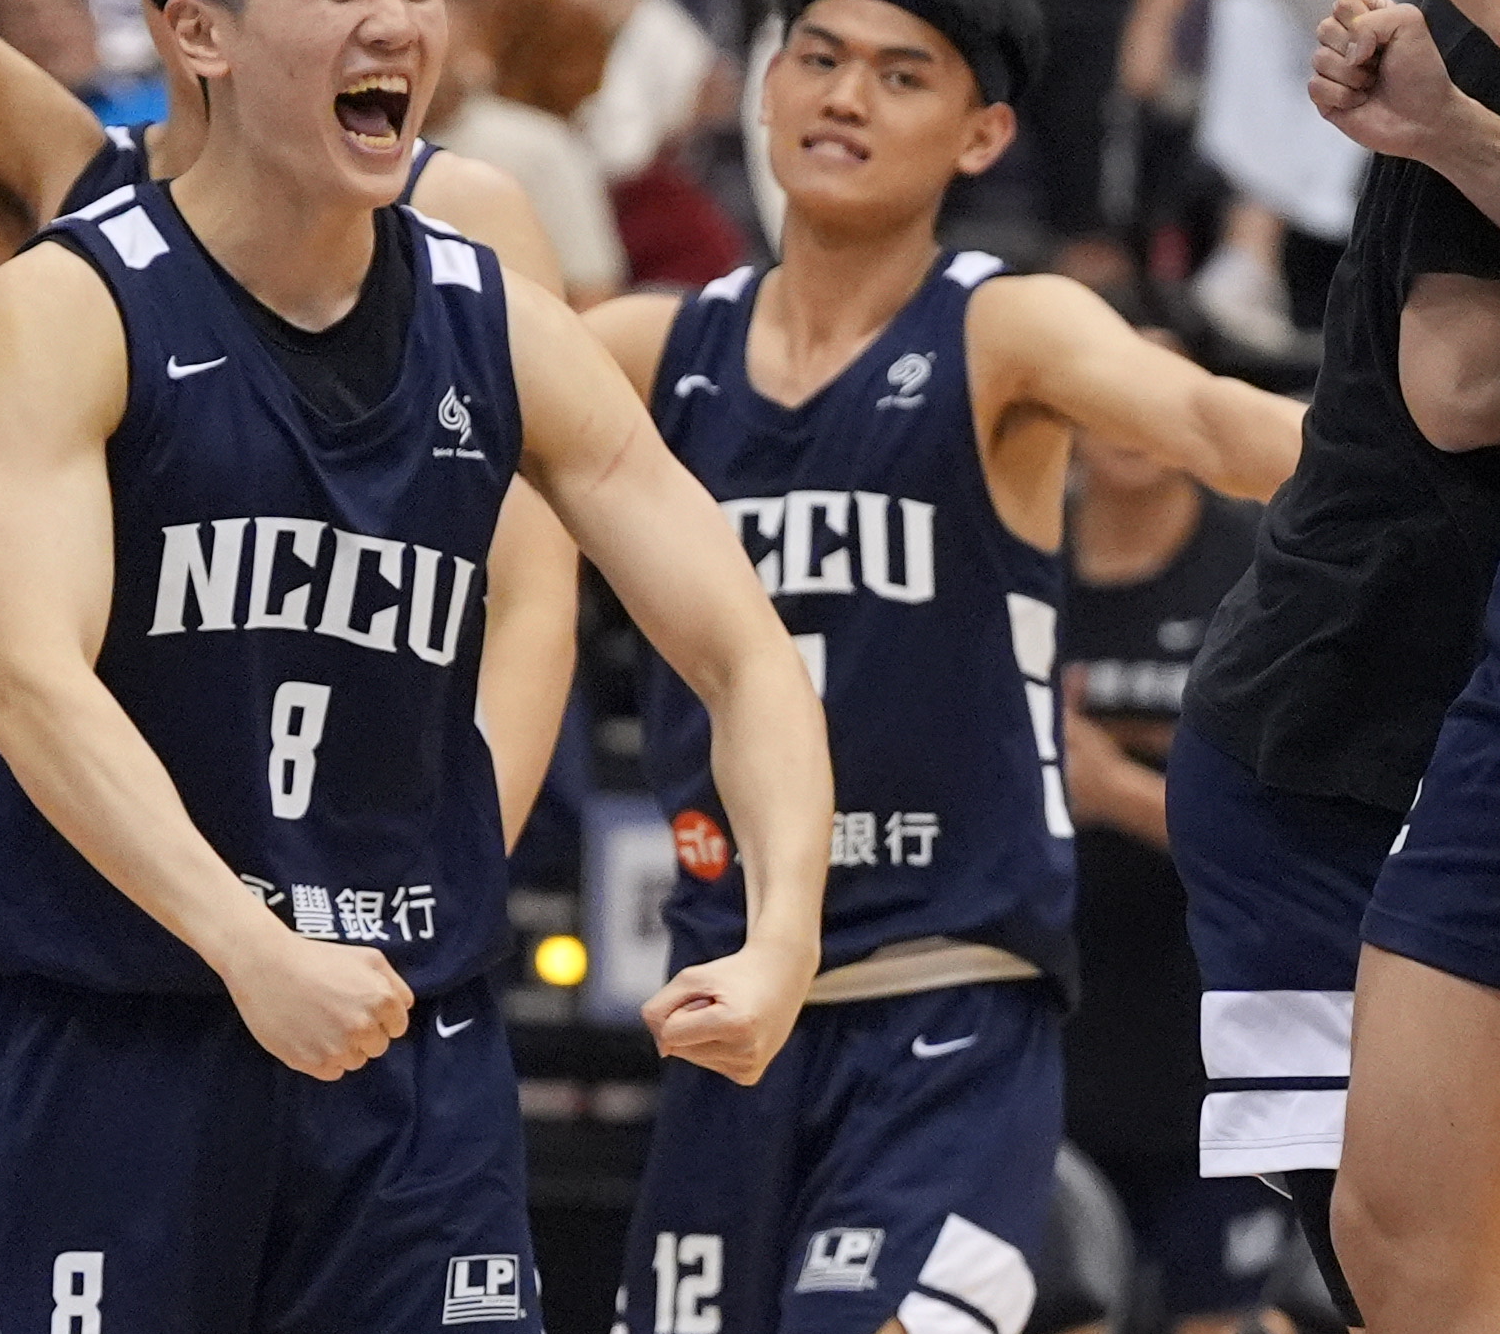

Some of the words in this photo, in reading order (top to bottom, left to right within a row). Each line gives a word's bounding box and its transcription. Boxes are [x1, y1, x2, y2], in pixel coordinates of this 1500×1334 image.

[147, 516, 476, 667] NCCU
[719, 489, 937, 605] CCU
[268, 680, 331, 820] 8
[453, 1259, 514, 1297] LP
